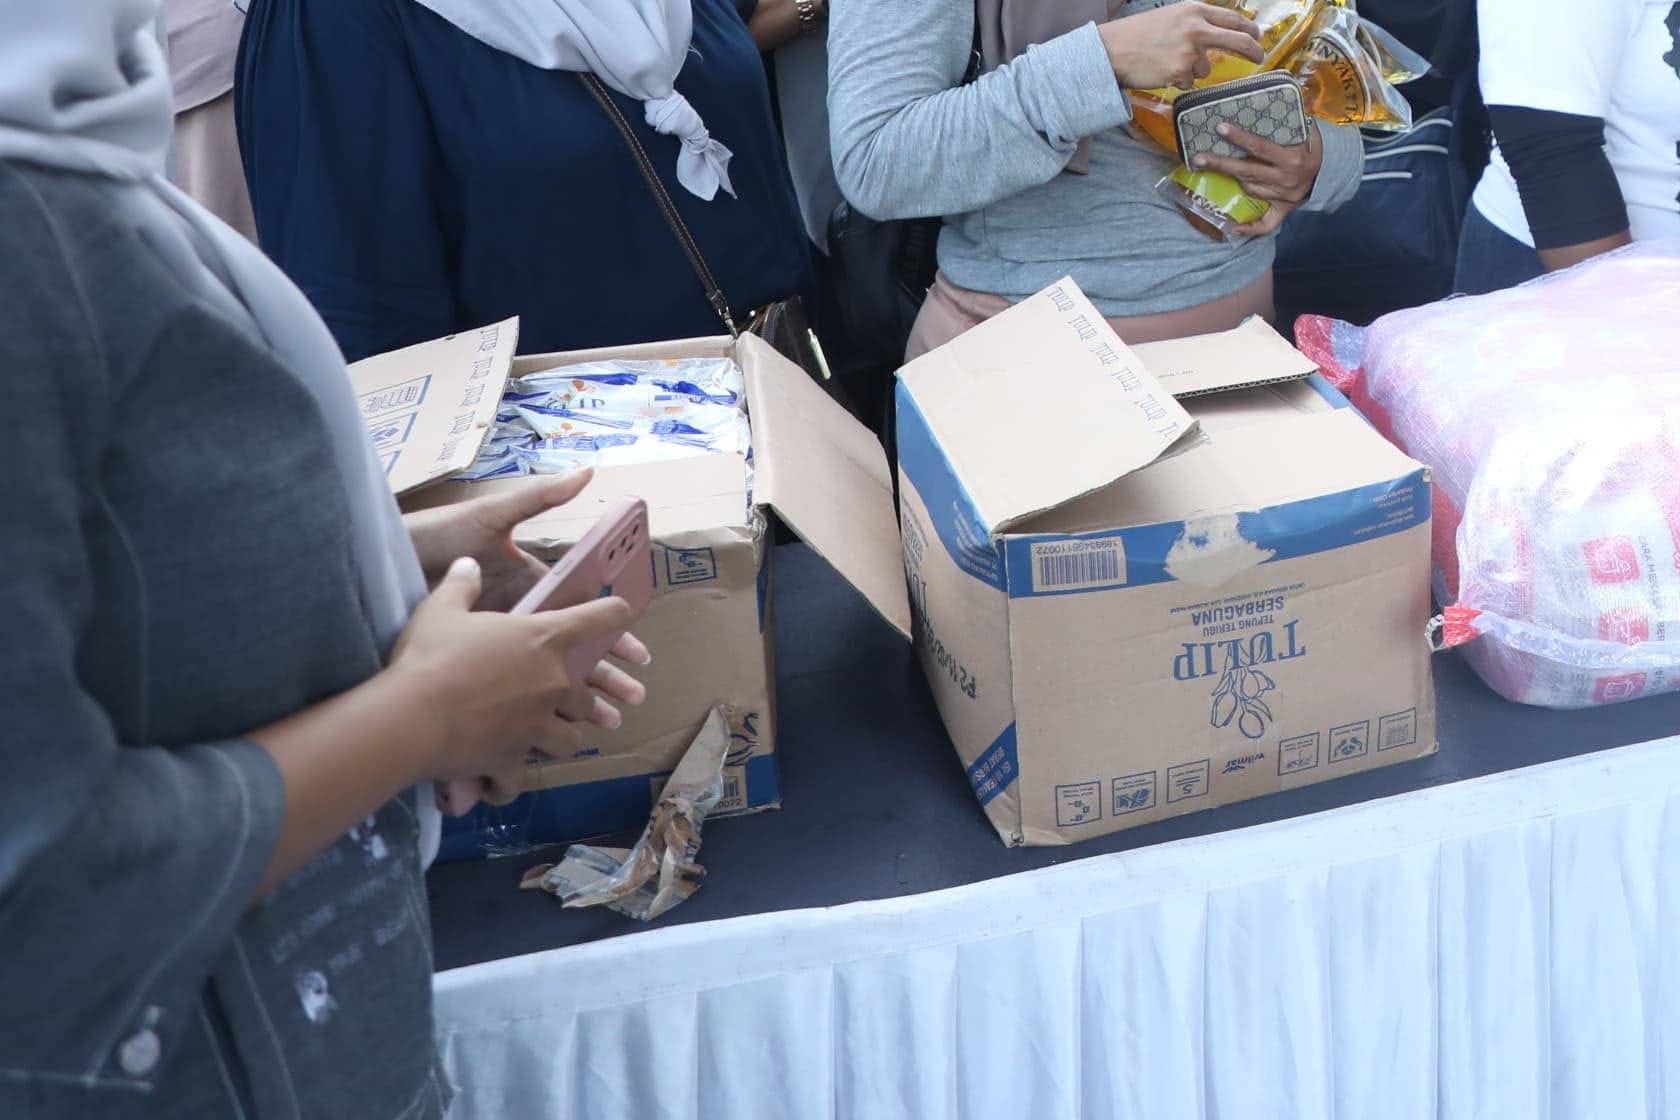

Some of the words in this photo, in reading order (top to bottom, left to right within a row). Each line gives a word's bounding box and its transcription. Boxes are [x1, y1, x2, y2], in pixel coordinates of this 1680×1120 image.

[1191, 595, 1285, 626] SERBAGUNA
[1202, 622, 1237, 637] TERIGU
[1238, 614, 1275, 630] TEPUNG
[1173, 618, 1306, 681] TULIP
[1225, 752, 1265, 768] wilmar
